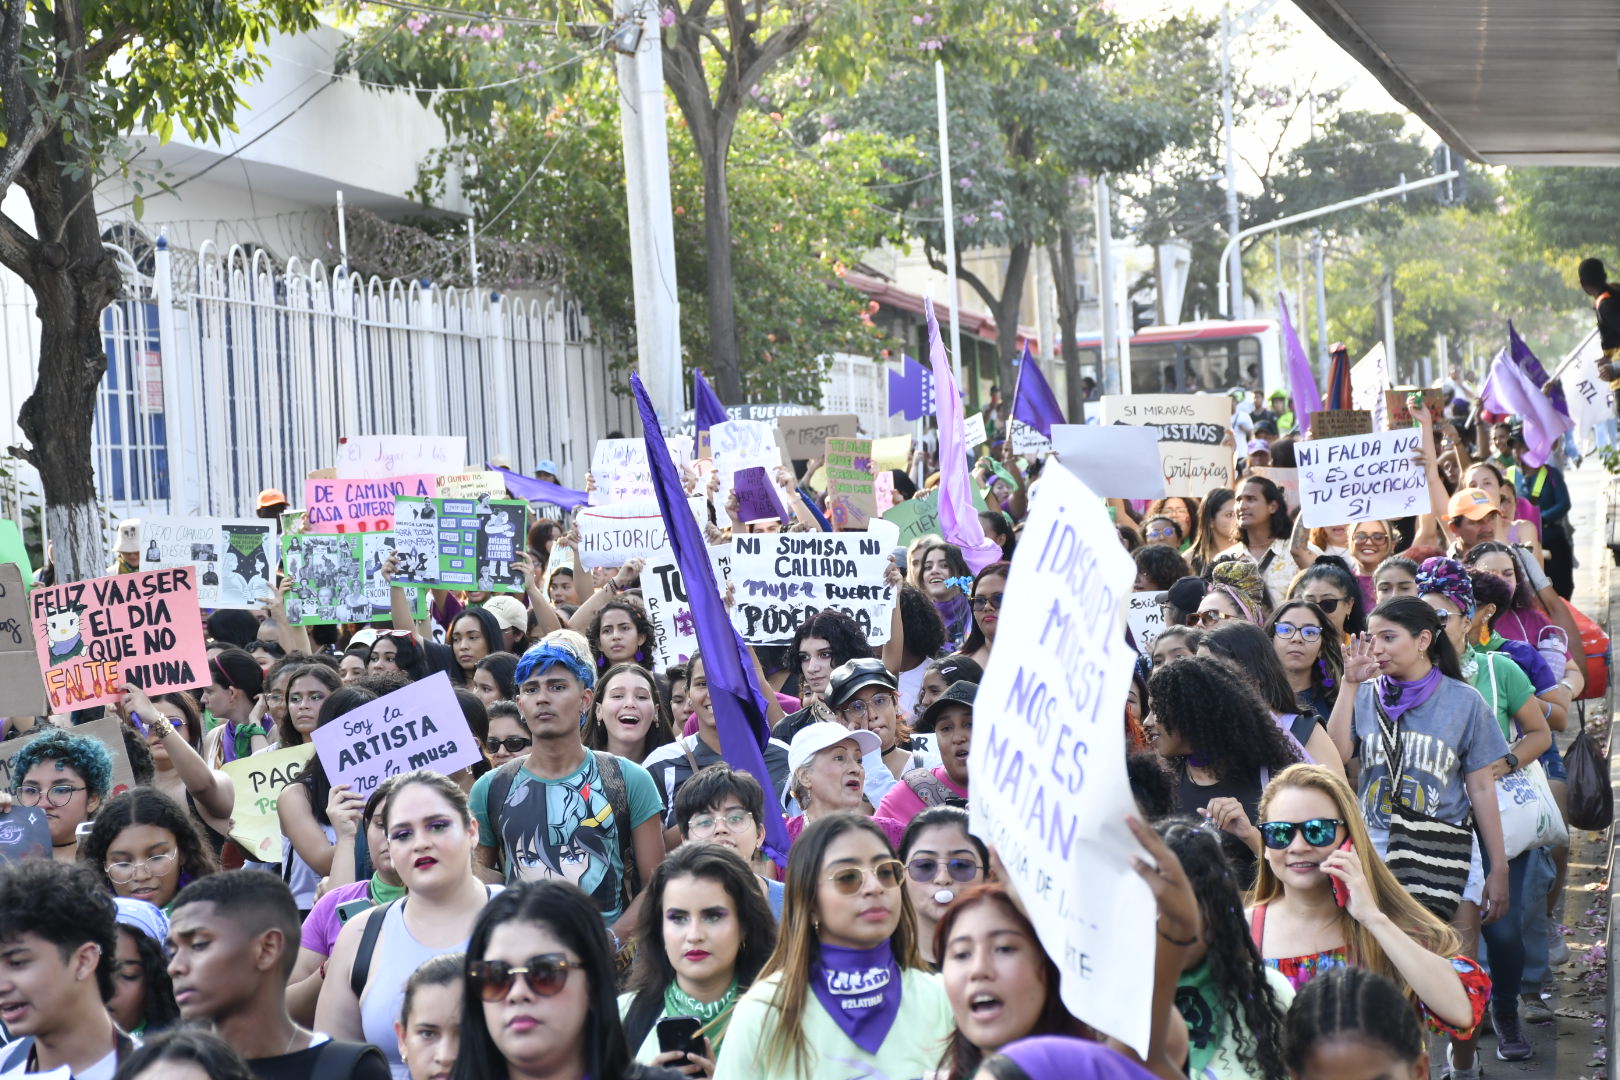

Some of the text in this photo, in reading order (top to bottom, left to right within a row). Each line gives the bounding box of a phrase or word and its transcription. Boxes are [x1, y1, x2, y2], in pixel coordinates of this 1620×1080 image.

[726, 408, 742, 420] SE
[1124, 405, 1137, 416] SI
[1328, 440, 1381, 463] FALDA
[1394, 436, 1419, 455] NO
[1326, 459, 1409, 483] ES CORTA
[315, 479, 428, 503] DE CAMINO A
[1309, 471, 1426, 504] TU EDUCACIÓN
[308, 500, 395, 525] CASA QUIERO
[736, 536, 881, 557] NI SUMISA NI
[775, 556, 858, 578] CALLADA
[34, 583, 88, 619] FELIZ
[825, 583, 892, 600] FUERTE
[89, 596, 172, 637] EL DÍA
[89, 627, 177, 664] QUE NO
[45, 661, 120, 708] FALTE
[153, 660, 196, 685] UNA
[343, 706, 403, 737] Soy la
[338, 715, 438, 772] ARTISTA
[354, 775, 379, 793] no
[408, 740, 458, 770] musa
